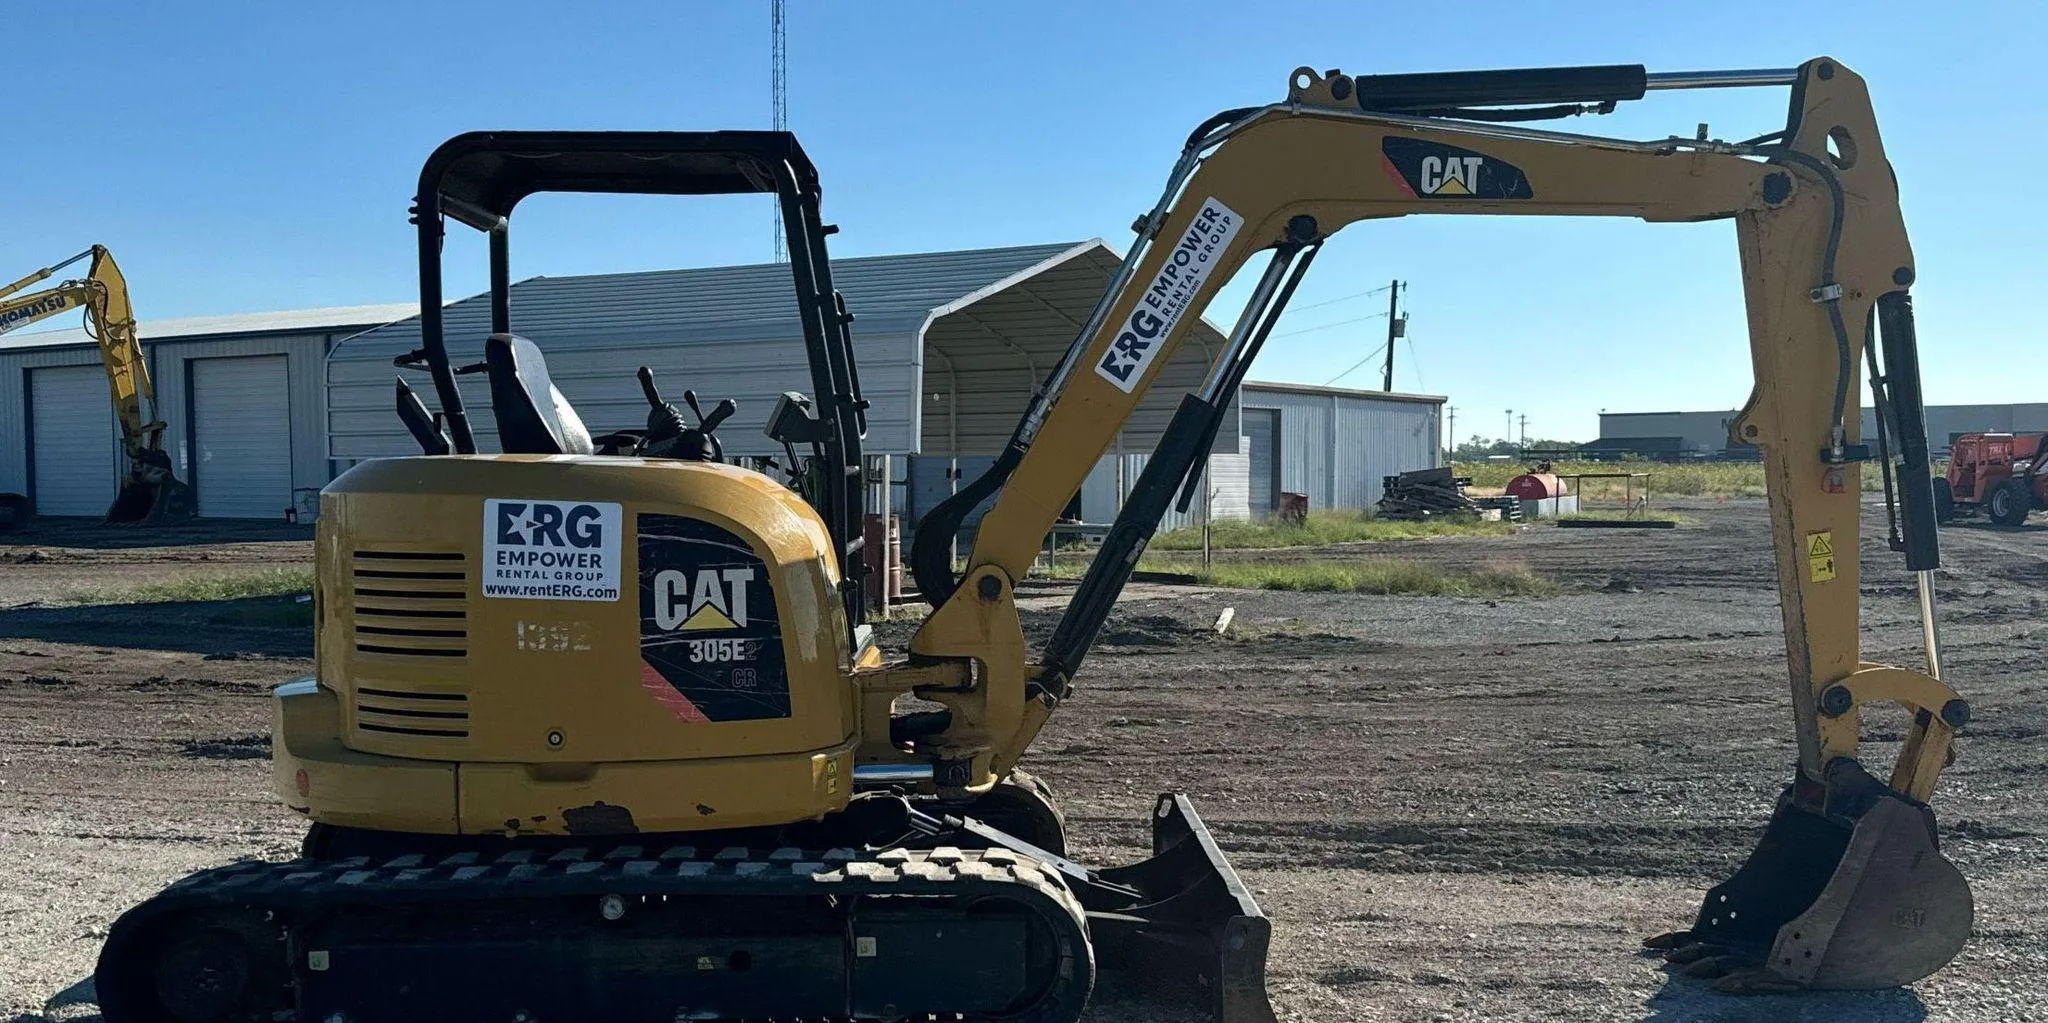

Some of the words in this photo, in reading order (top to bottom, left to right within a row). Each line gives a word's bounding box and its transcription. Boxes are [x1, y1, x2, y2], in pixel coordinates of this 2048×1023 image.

[1421, 156, 1483, 194] CAT
[1146, 206, 1221, 310] EMPOWER
[1162, 267, 1200, 317] RENTAL
[1199, 215, 1232, 263] GROUP
[1101, 309, 1164, 382] ERG
[497, 503, 602, 549] ERG
[496, 551, 602, 569] EMPOWER
[496, 569, 549, 580] RENTAL
[554, 571, 603, 582] GROUP
[485, 584, 618, 599] www.rentERG.com
[654, 569, 754, 631] CAT
[731, 667, 758, 689] CR
